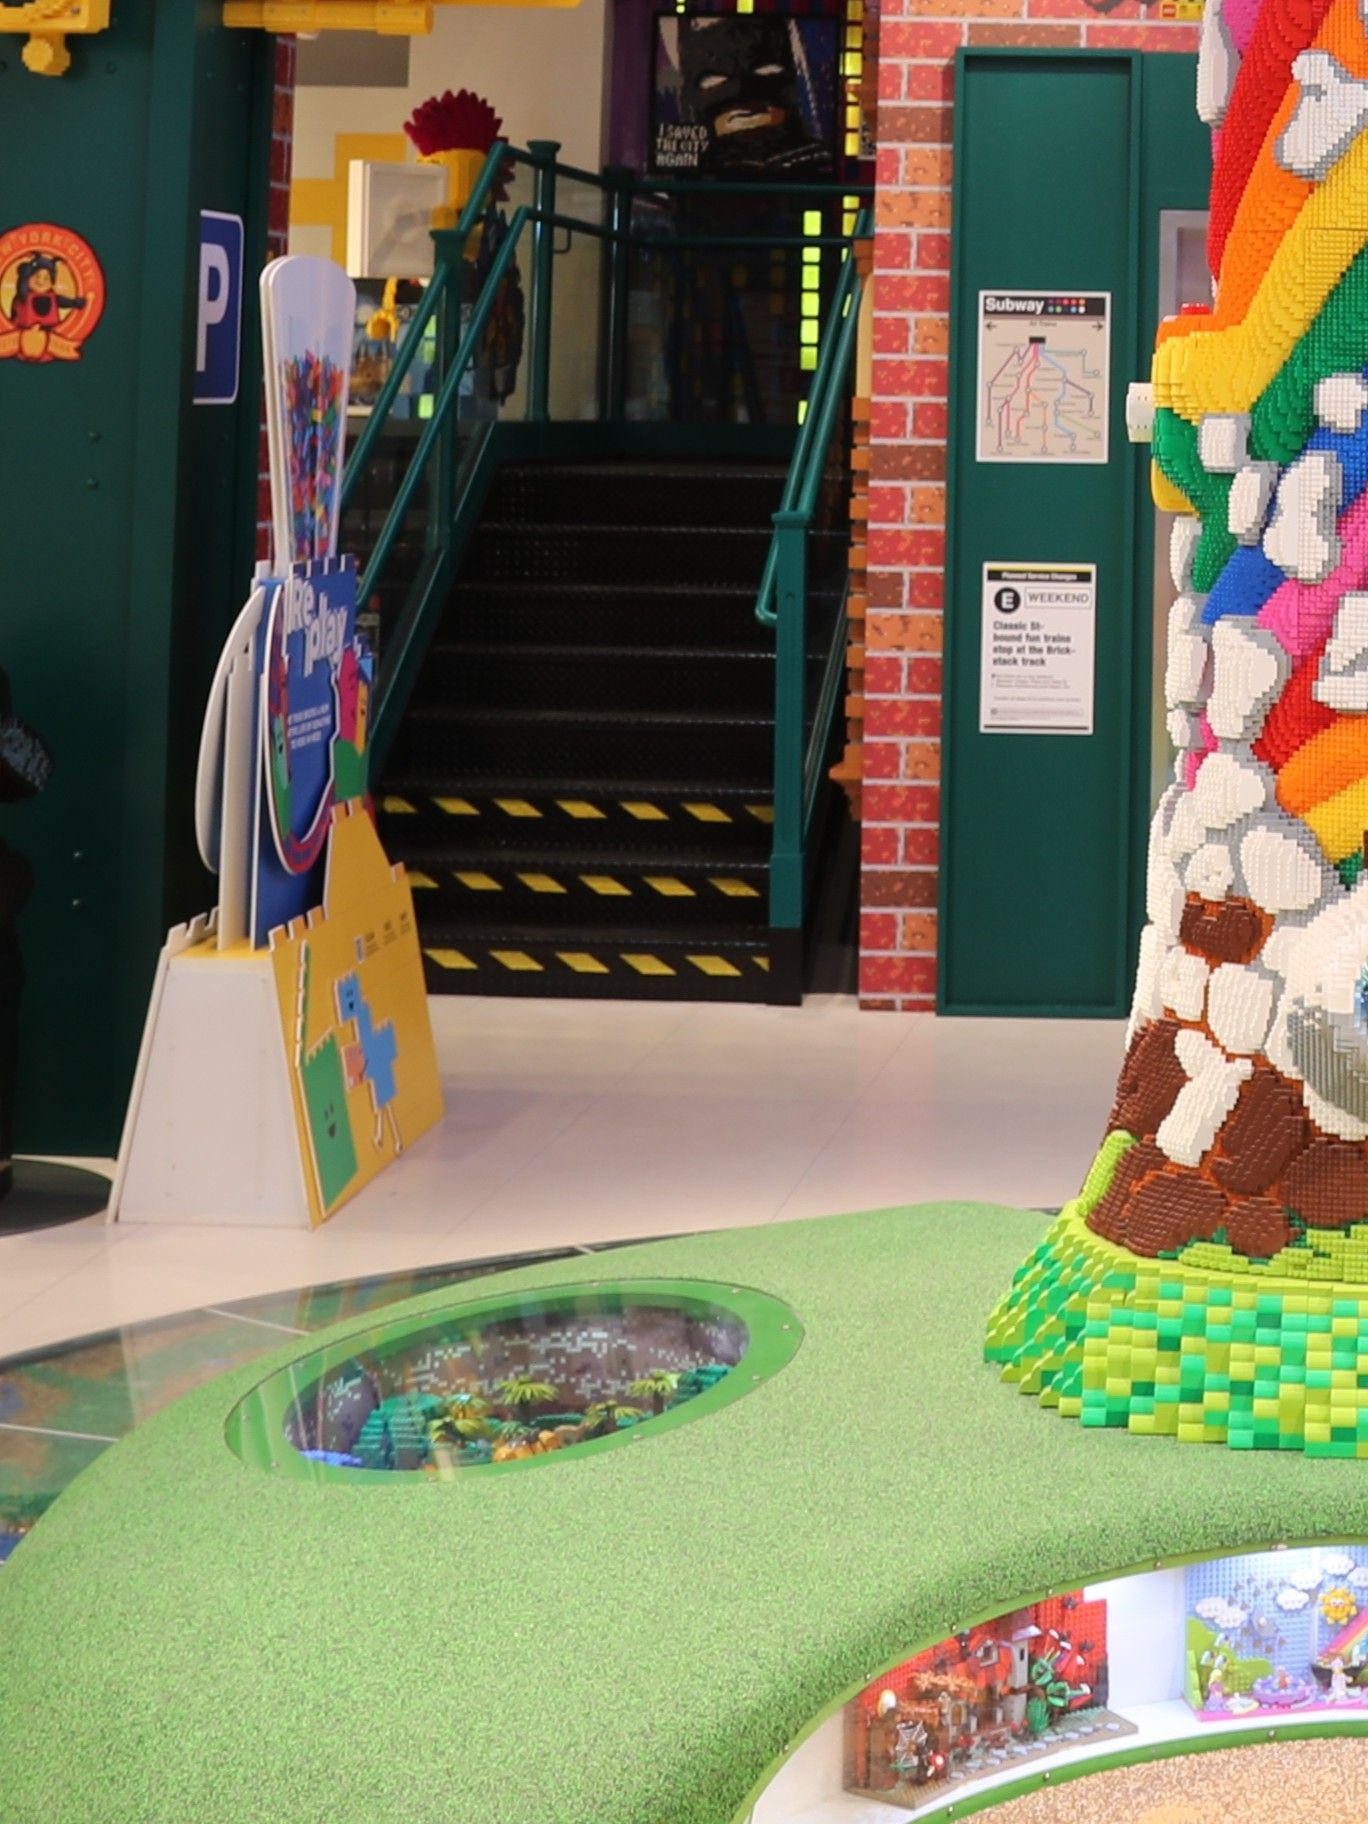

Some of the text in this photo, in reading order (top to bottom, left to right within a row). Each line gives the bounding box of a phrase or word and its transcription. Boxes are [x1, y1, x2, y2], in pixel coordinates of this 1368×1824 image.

[196, 242, 230, 372] P
[985, 297, 1044, 315] Subway
[1002, 591, 1089, 609] E WEEKEND
